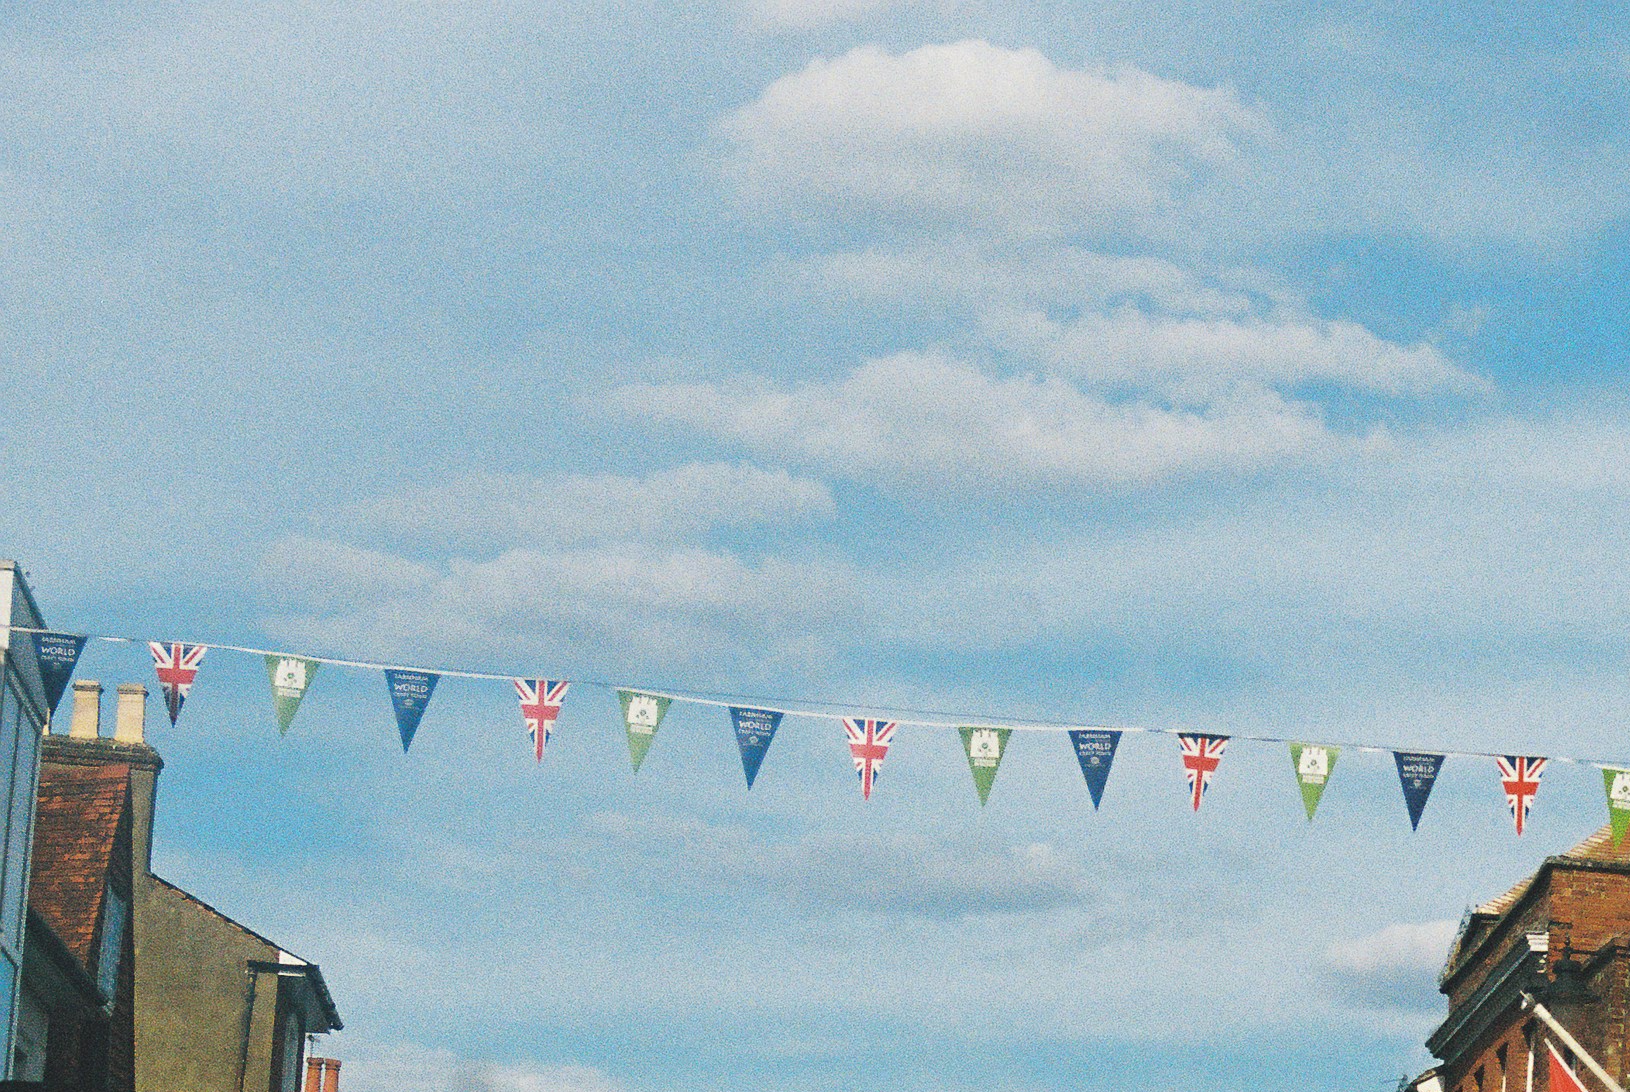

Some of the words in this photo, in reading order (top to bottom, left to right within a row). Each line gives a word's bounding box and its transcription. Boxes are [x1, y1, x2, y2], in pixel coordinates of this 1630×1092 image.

[41, 646, 76, 656] WORLD
[394, 683, 429, 693] WORLD
[738, 721, 772, 731] WORLD
[1079, 741, 1111, 751] WORLD
[1403, 764, 1435, 774] WORLD
